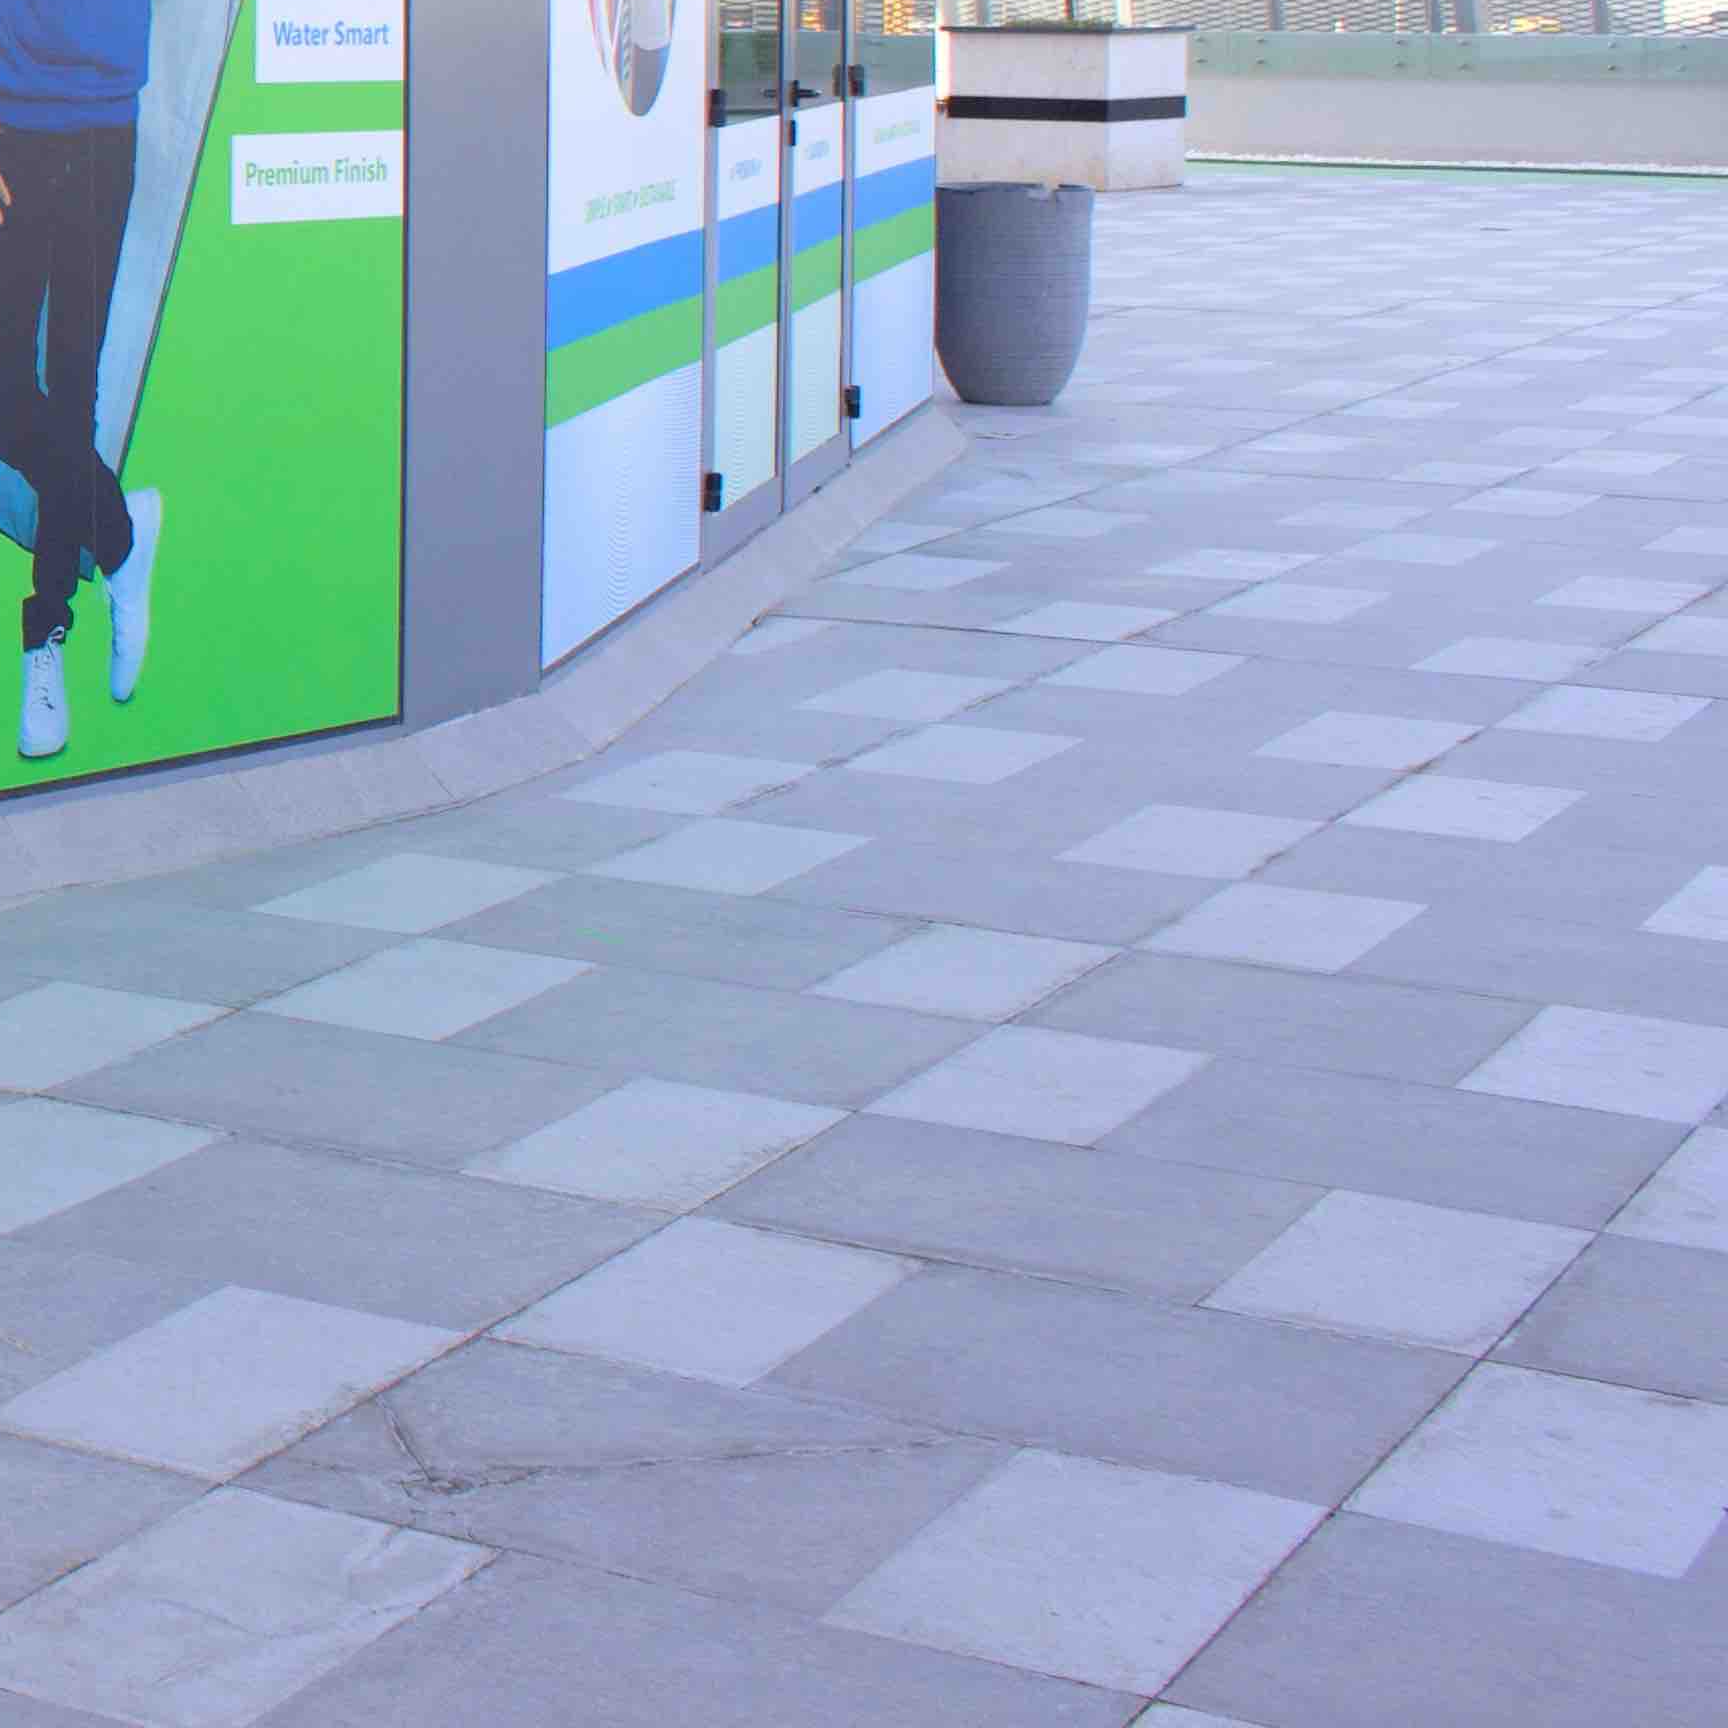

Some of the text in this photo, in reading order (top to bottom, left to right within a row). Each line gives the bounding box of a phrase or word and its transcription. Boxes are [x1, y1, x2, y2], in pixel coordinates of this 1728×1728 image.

[272, 19, 390, 48] Water Smart
[244, 155, 388, 188] Premium Finish
